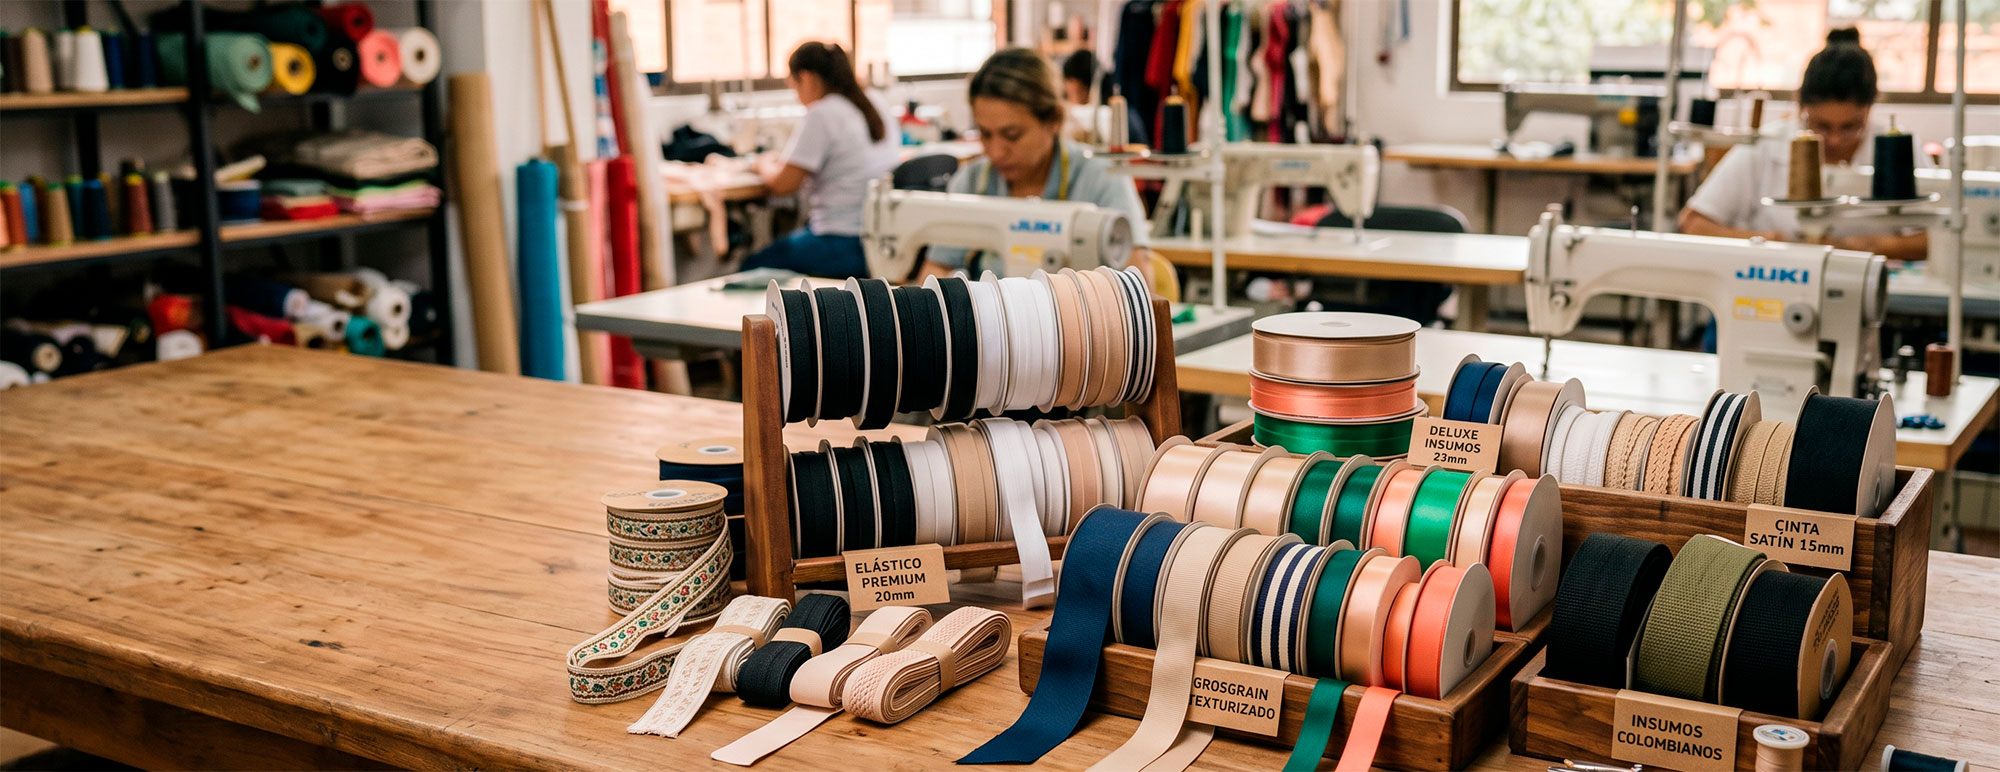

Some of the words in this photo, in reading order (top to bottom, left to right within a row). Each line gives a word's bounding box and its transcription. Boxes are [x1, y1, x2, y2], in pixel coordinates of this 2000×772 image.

[1735, 265, 1809, 284] JUKI
[1429, 425, 1479, 440] DELUXE
[1425, 438, 1481, 453] INSUMOS
[1433, 452, 1467, 464] 23mm
[1775, 519, 1820, 535] CINTA
[1749, 532, 1794, 549] SATÍN
[1800, 539, 1844, 555] 15mm
[855, 557, 922, 574] ELÁSTICO
[862, 572, 926, 588] PREMIUM
[875, 590, 915, 602] 20mm
[1193, 677, 1269, 701] GROSGRAIN
[1188, 693, 1275, 719] TEXTURIZADO
[1631, 714, 1703, 738] INSUMOS
[1617, 731, 1723, 760] COLOMBIANOS
